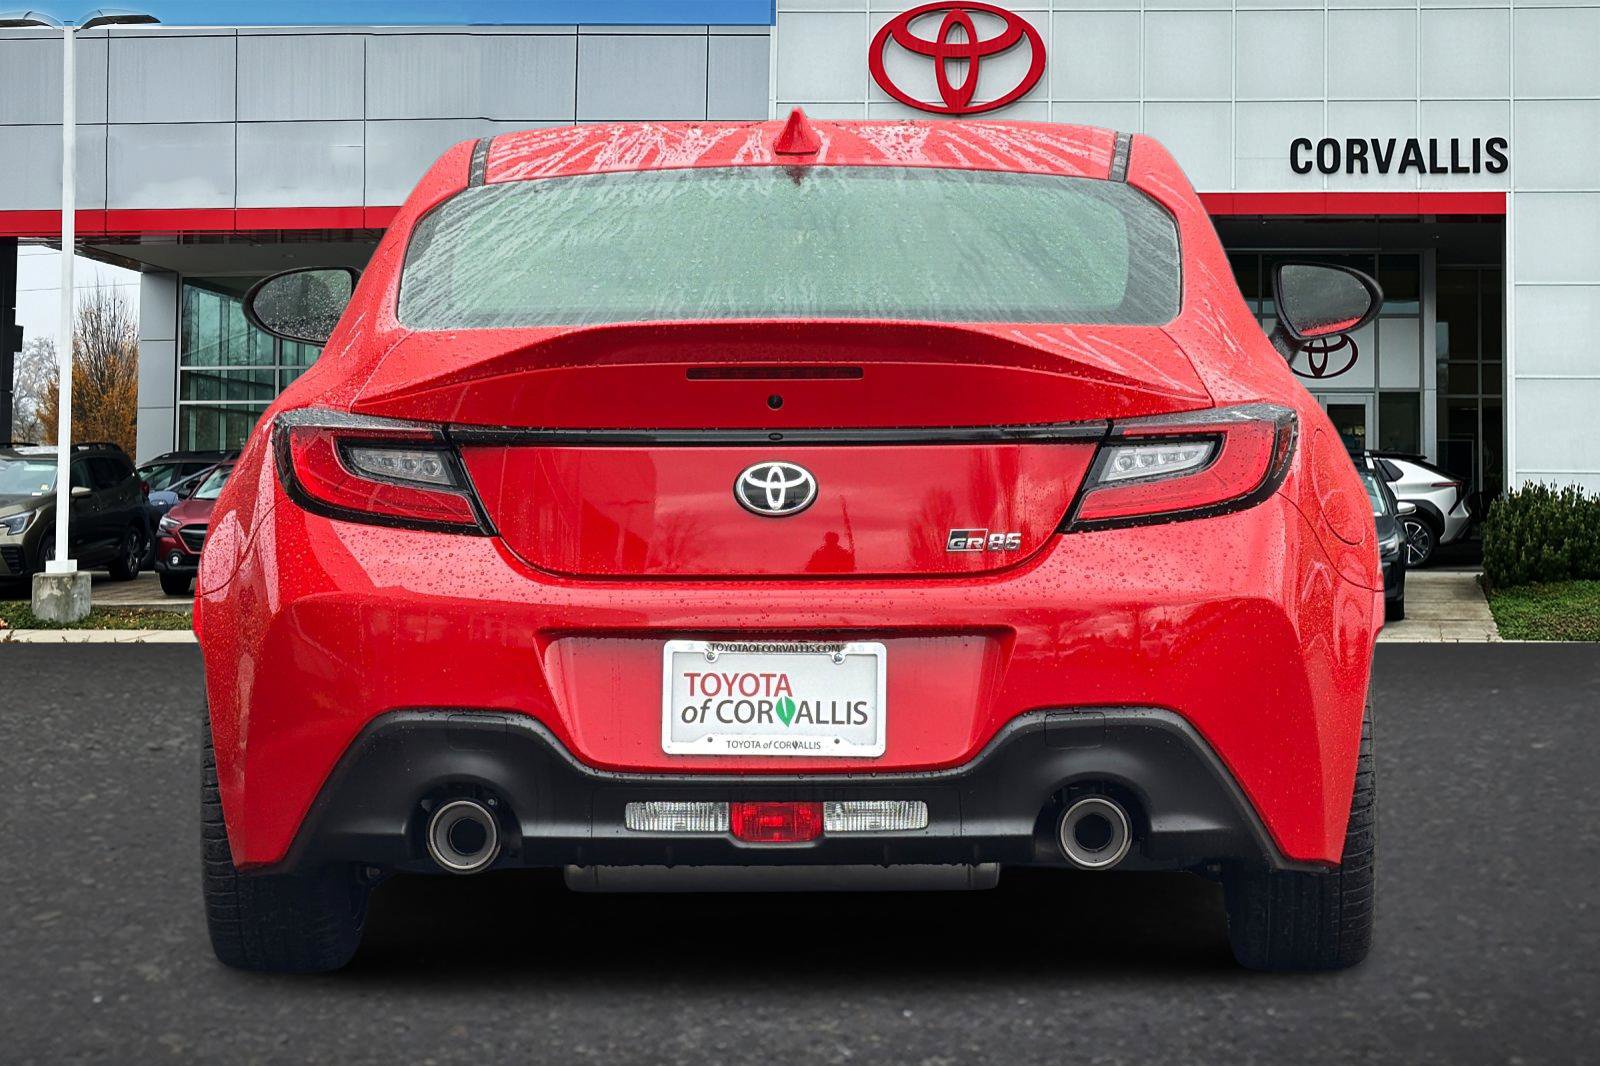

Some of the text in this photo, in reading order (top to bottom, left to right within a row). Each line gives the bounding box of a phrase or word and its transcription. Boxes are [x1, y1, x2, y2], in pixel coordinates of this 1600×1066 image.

[1290, 138, 1509, 174] CORVALLIS
[948, 532, 1021, 550] GR 86
[684, 673, 793, 697] TOYOTA
[681, 697, 868, 726] of CORVALLIS
[727, 740, 821, 750] TOYOTA of CORVALLIS
